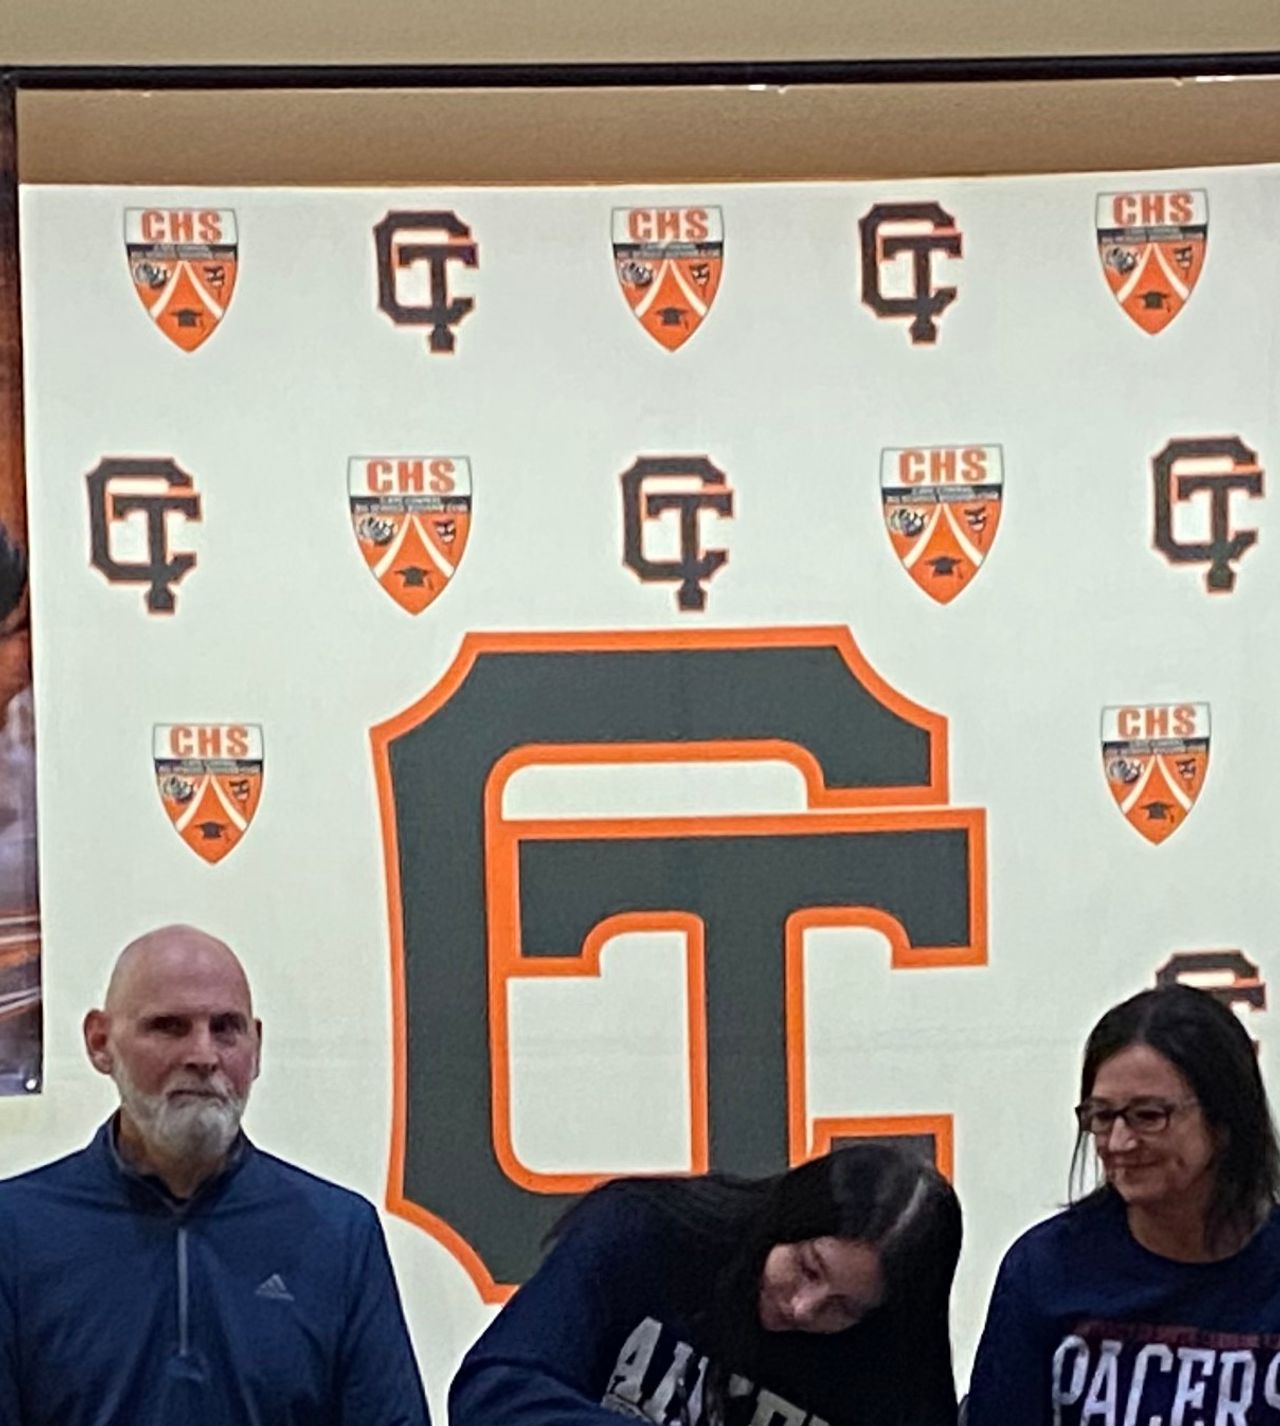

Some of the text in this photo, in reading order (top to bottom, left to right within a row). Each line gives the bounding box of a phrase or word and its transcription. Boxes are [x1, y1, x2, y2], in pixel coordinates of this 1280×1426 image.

[141, 209, 223, 243] CHS
[628, 206, 709, 242] CHS
[1113, 193, 1193, 226] CHS
[366, 458, 455, 495] CHS
[898, 447, 988, 484] CHS
[1116, 706, 1196, 739] CHS
[169, 725, 249, 759] CHS
